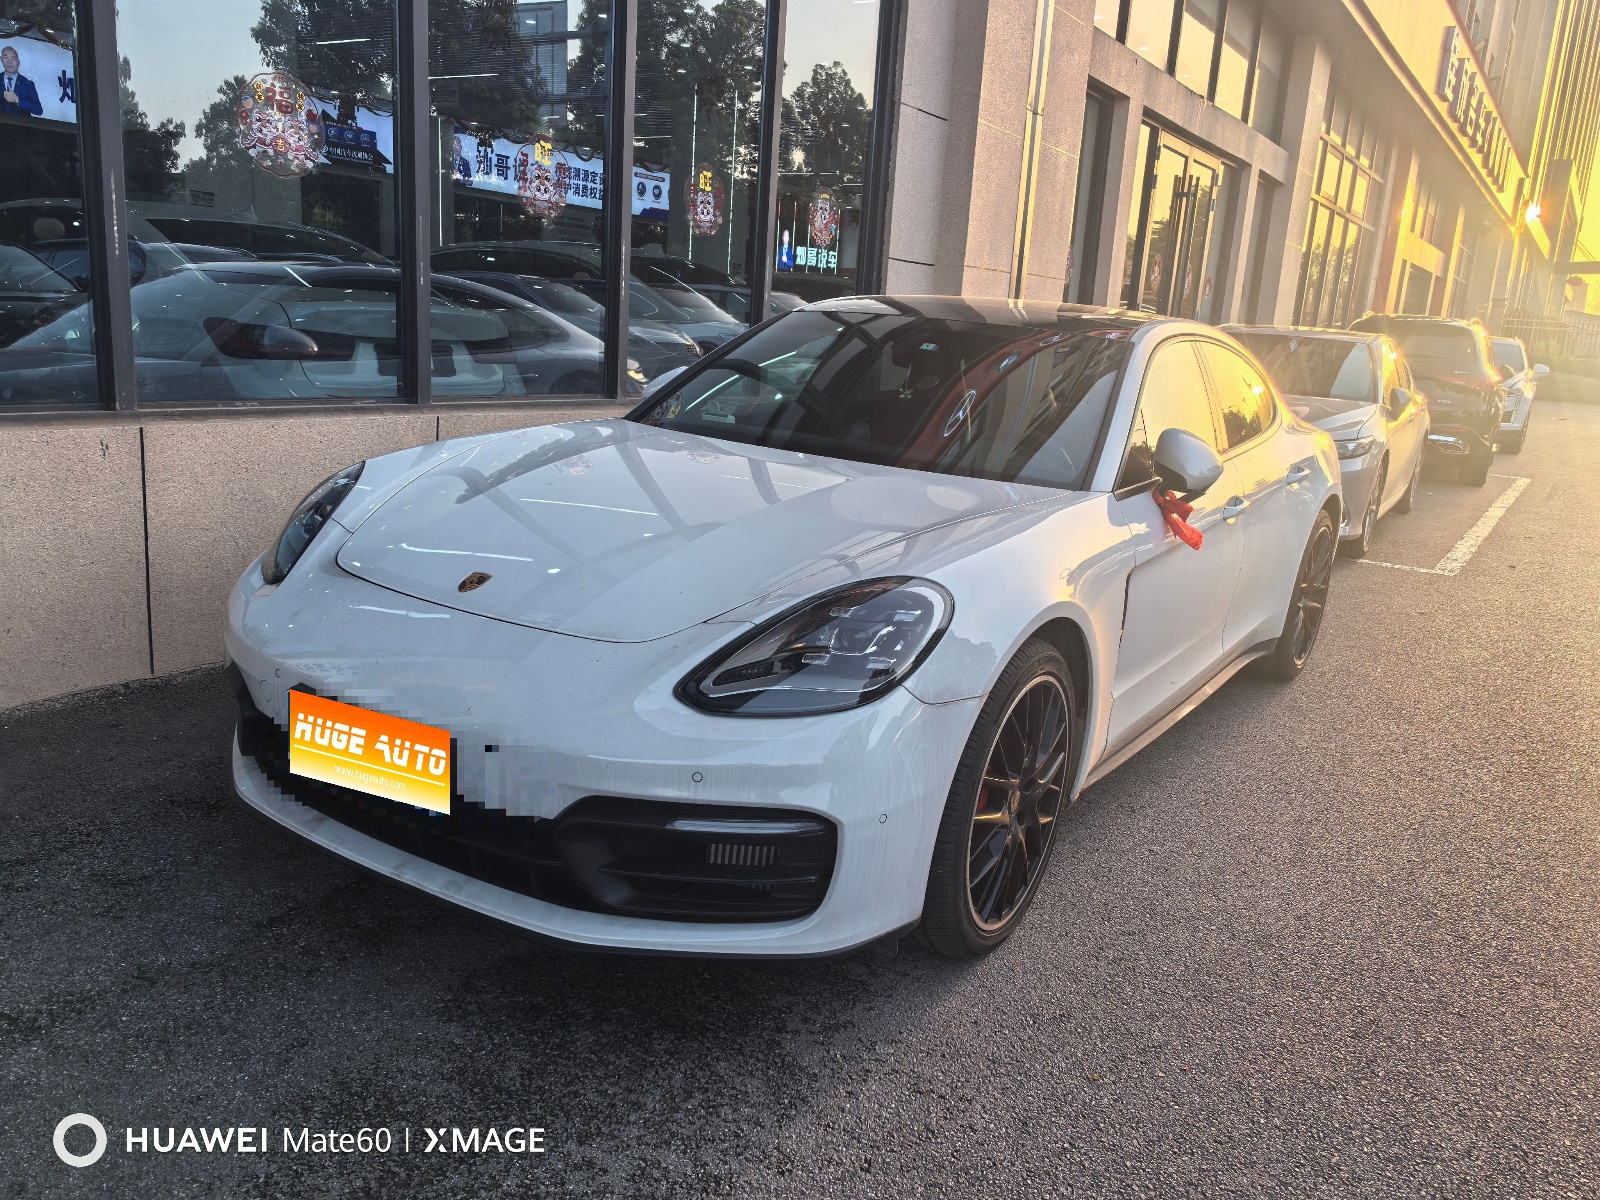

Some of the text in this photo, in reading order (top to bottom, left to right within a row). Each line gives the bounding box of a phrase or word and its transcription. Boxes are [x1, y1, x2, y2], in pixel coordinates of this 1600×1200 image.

[264, 82, 294, 114] 福
[535, 140, 552, 165] 旺
[699, 170, 712, 192] 旺
